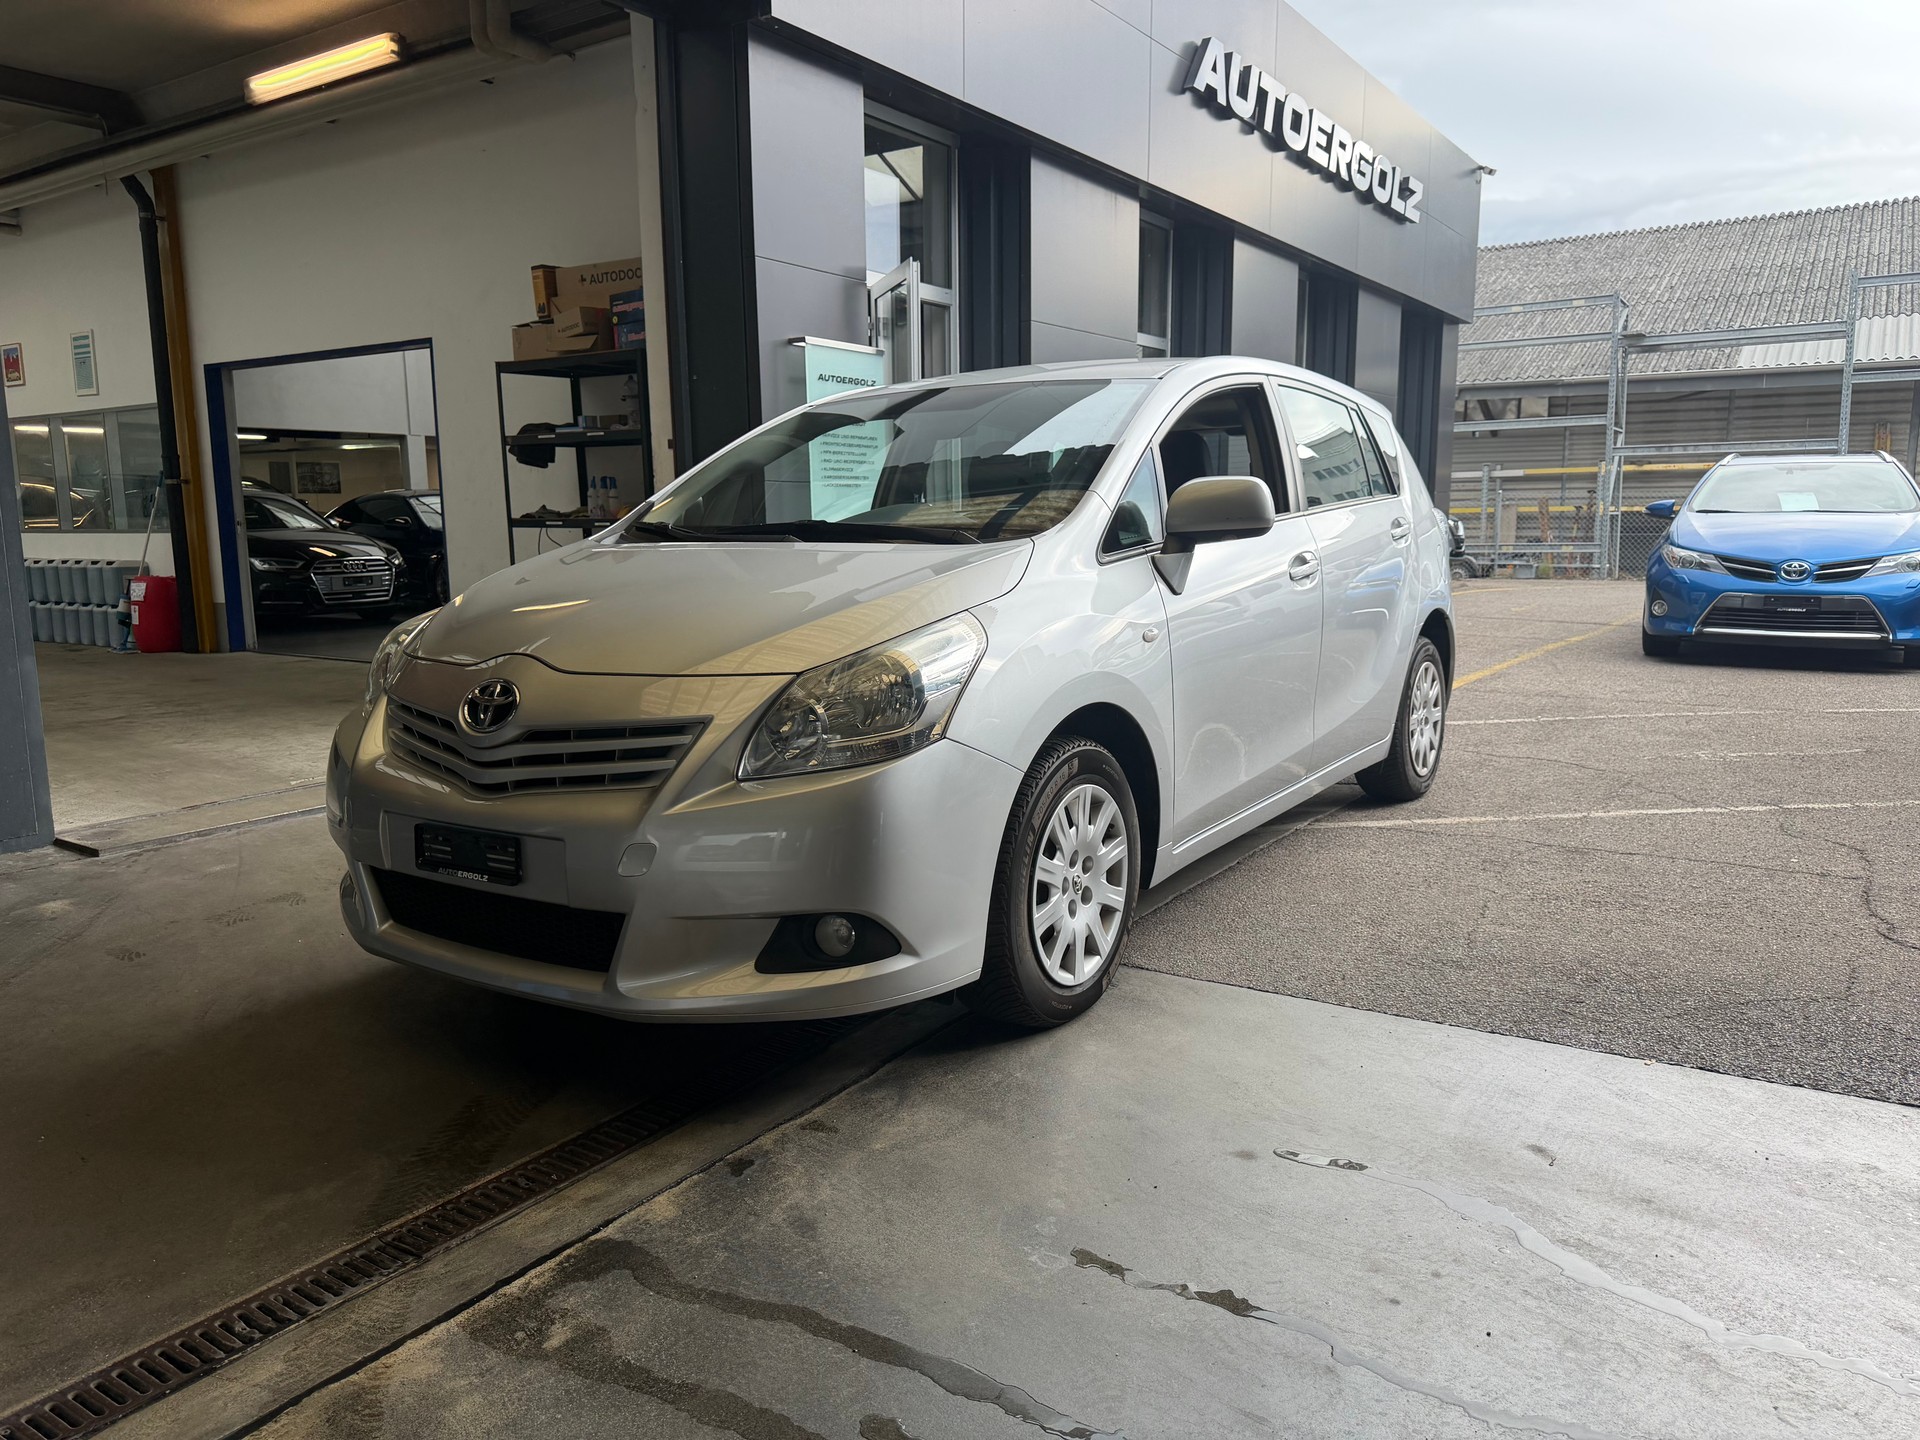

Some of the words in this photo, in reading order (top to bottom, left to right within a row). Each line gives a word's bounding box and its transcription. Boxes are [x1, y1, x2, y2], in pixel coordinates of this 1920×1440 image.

[1187, 36, 1424, 224] AUTOERGOLZ
[589, 267, 642, 285] AUTODOC
[818, 373, 877, 387] AUTOERGOLZ
[438, 867, 489, 882] AUTOERGOLZ
